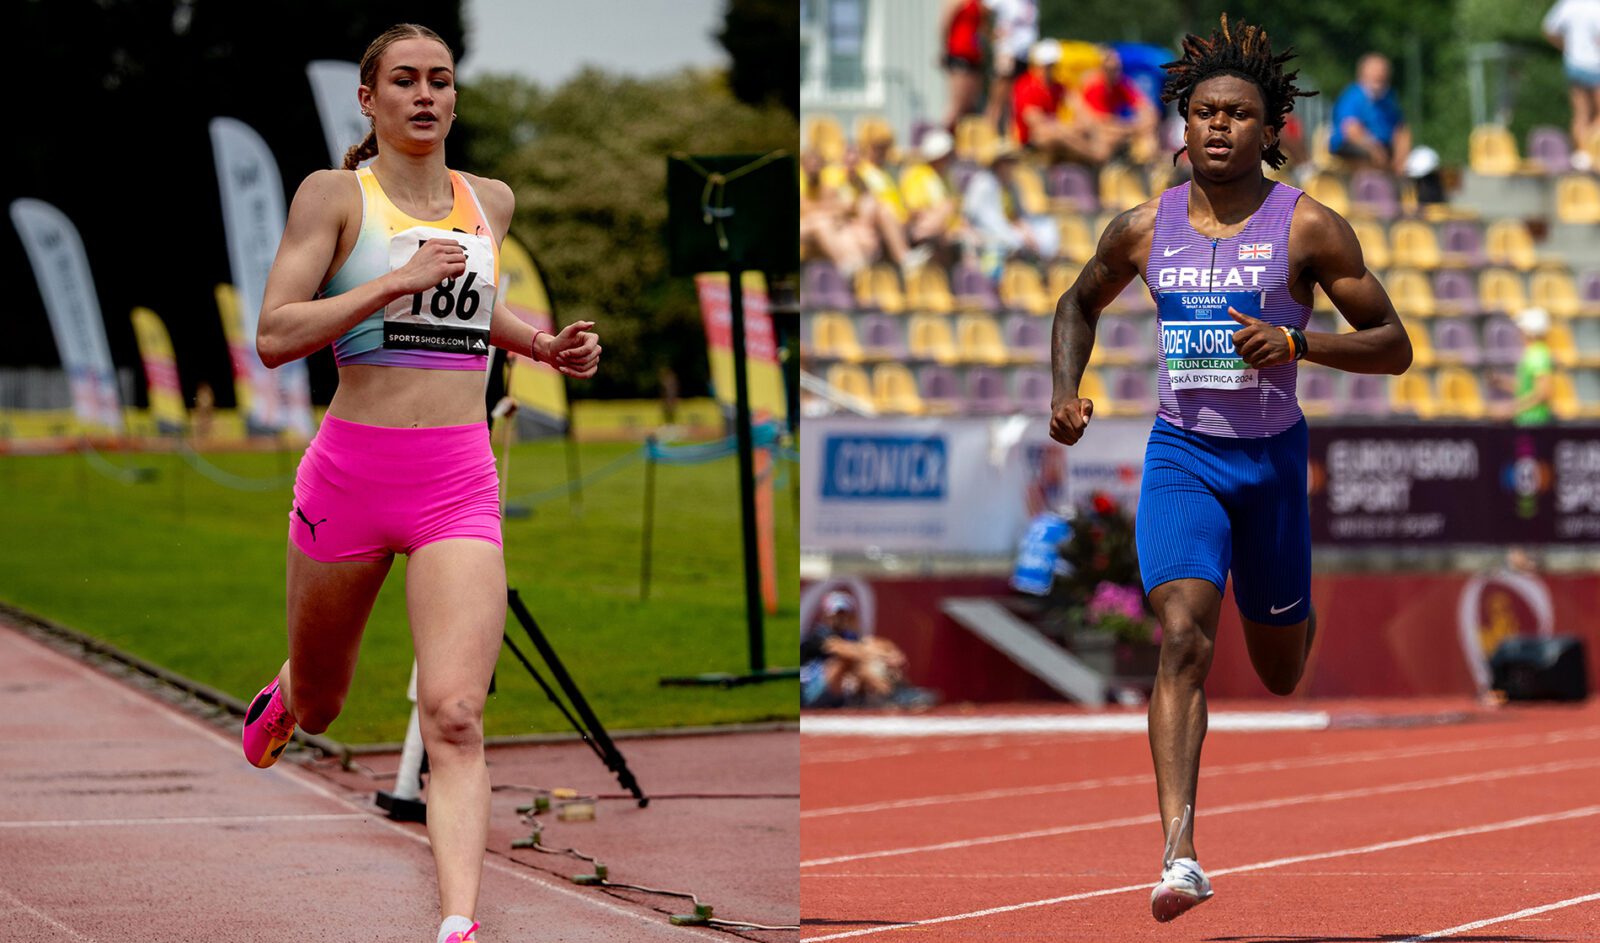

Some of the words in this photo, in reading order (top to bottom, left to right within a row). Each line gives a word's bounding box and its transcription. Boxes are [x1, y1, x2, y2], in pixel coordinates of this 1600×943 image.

[1158, 266, 1265, 287] GREAT
[1181, 296, 1227, 305] SLOVAKIA
[1177, 360, 1200, 369] RUN
[1193, 374, 1234, 384] BYSTRICA
[1235, 374, 1253, 384] 2024
